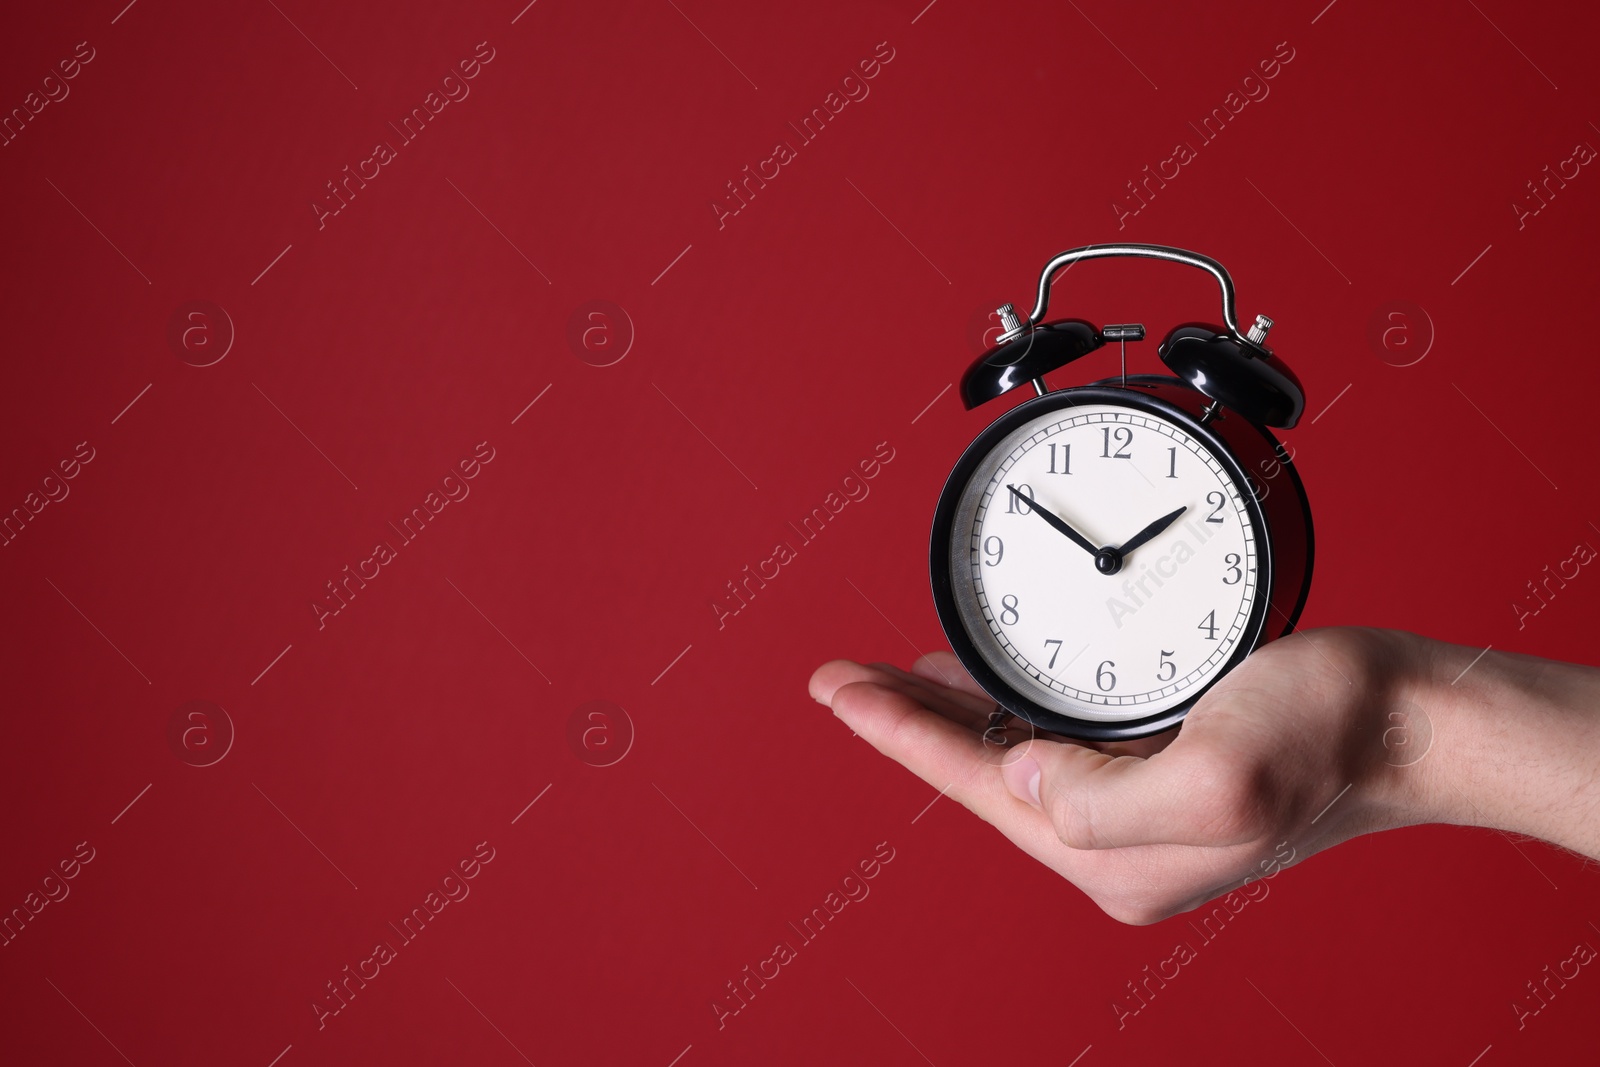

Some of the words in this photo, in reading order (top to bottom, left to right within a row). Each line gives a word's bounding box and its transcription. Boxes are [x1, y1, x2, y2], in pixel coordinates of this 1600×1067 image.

[1046, 443, 1073, 475] 11
[1099, 427, 1133, 460] 12
[1165, 446, 1179, 479] 1
[1005, 483, 1035, 516] 10
[1205, 491, 1226, 524] 2
[983, 535, 1004, 567] 9
[1222, 553, 1243, 585] 3
[999, 594, 1020, 626] 8
[1197, 609, 1220, 641] 4
[1043, 639, 1063, 669] 7
[1156, 649, 1177, 682] 5
[1095, 660, 1117, 692] 6
